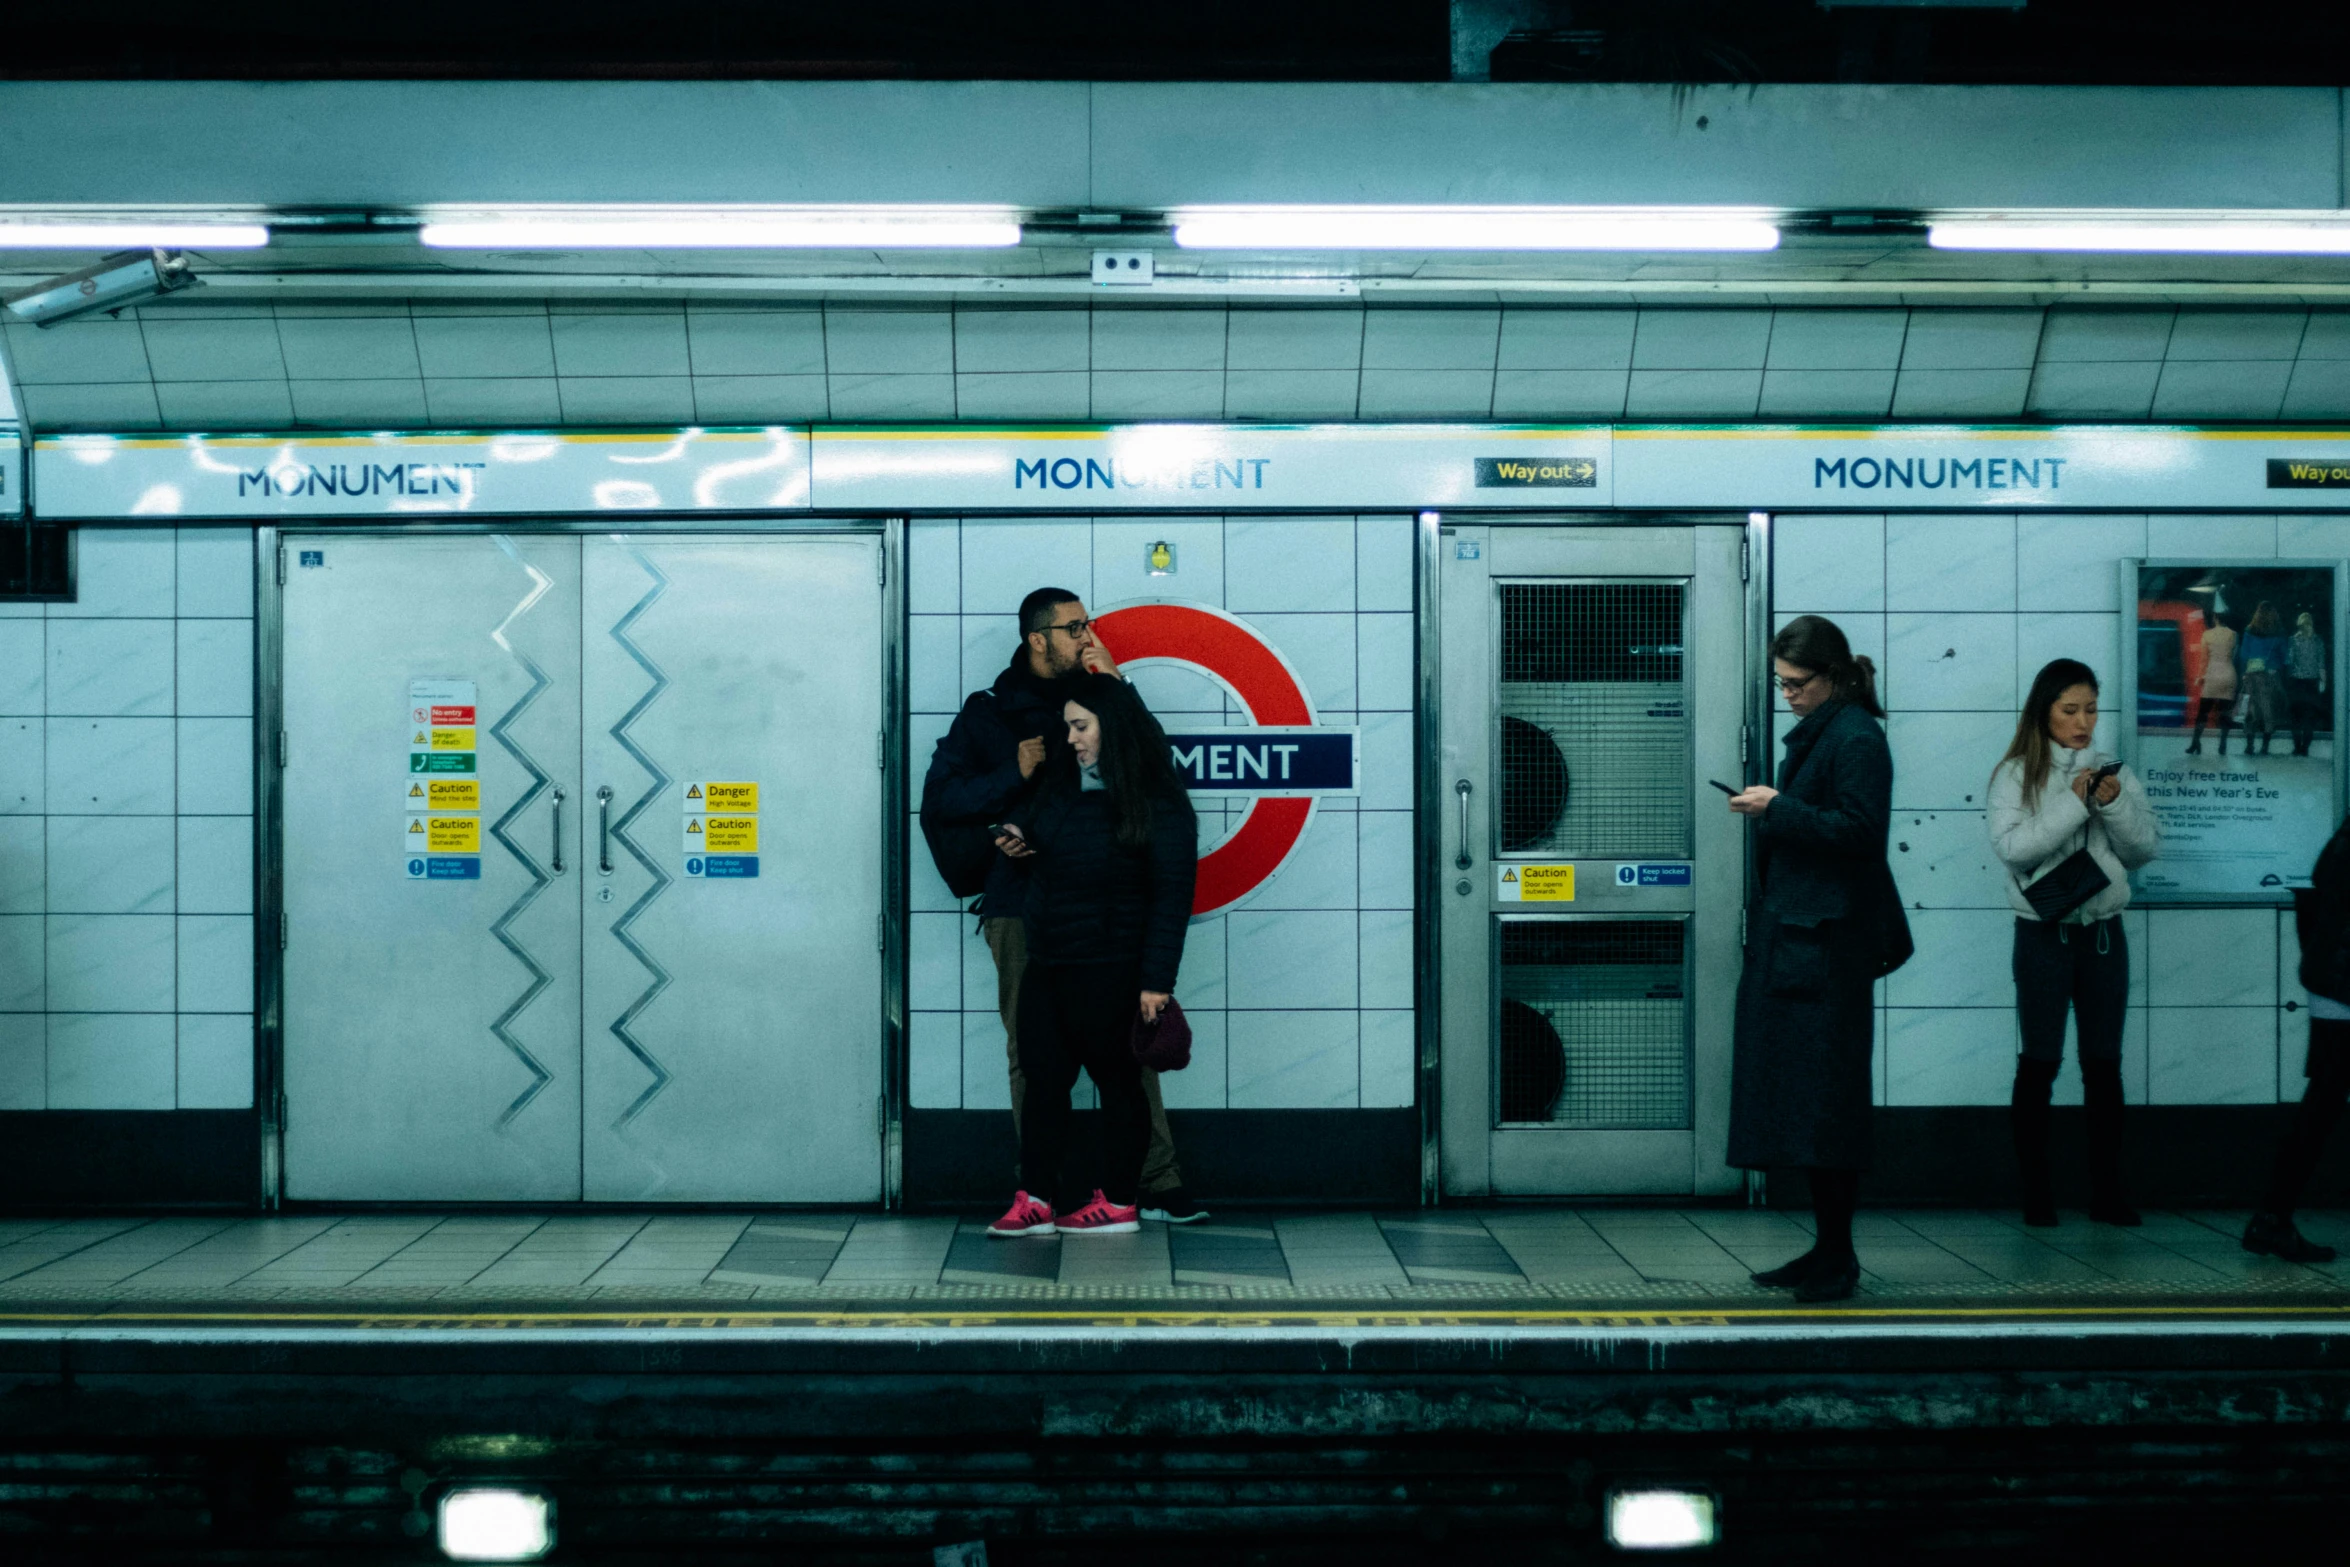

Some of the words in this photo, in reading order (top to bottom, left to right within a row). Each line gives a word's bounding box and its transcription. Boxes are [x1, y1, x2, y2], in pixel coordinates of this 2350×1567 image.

[1015, 458, 1270, 489] MONENT
[1498, 463, 1537, 482] Way
[1540, 464, 1572, 478] out
[1815, 457, 2066, 488] MONUMENT
[2290, 464, 2328, 483] Way
[2332, 468, 2350, 480] ou
[444, 710, 462, 718] entry
[1171, 745, 1299, 779] MENT
[2148, 769, 2184, 783] Enjoy
[2188, 770, 2216, 781] free
[2218, 772, 2259, 782] travel
[430, 784, 472, 793] Caution
[710, 786, 750, 798] Danger
[2147, 786, 2173, 797] this
[2176, 787, 2208, 797] New
[2211, 787, 2252, 799] Year's
[2256, 788, 2280, 798] Eve
[431, 820, 474, 829] Caution
[709, 820, 751, 828] Caution
[1524, 868, 1566, 877] Caution
